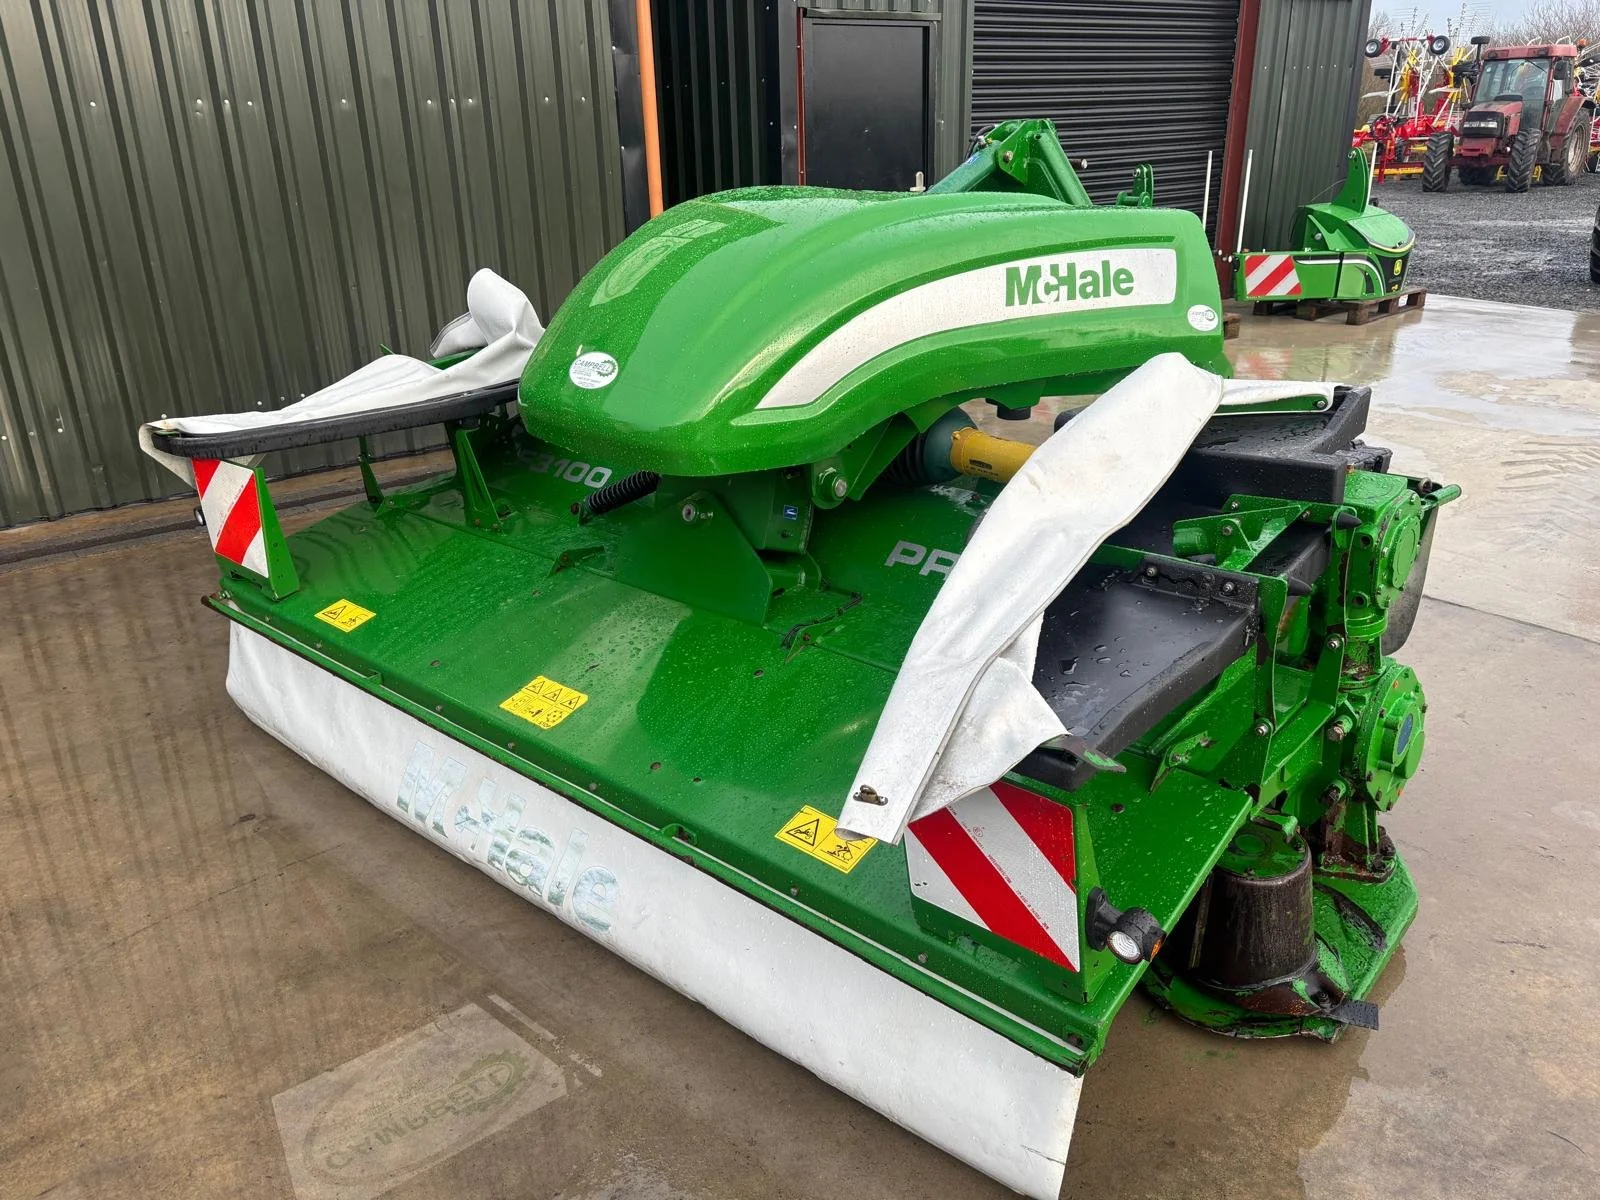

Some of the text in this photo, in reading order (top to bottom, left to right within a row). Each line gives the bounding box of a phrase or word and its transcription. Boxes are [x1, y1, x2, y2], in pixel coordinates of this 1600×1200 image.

[1005, 259, 1135, 307] McHale
[574, 359, 611, 373] CAMPBELL
[396, 740, 620, 933] McHale
